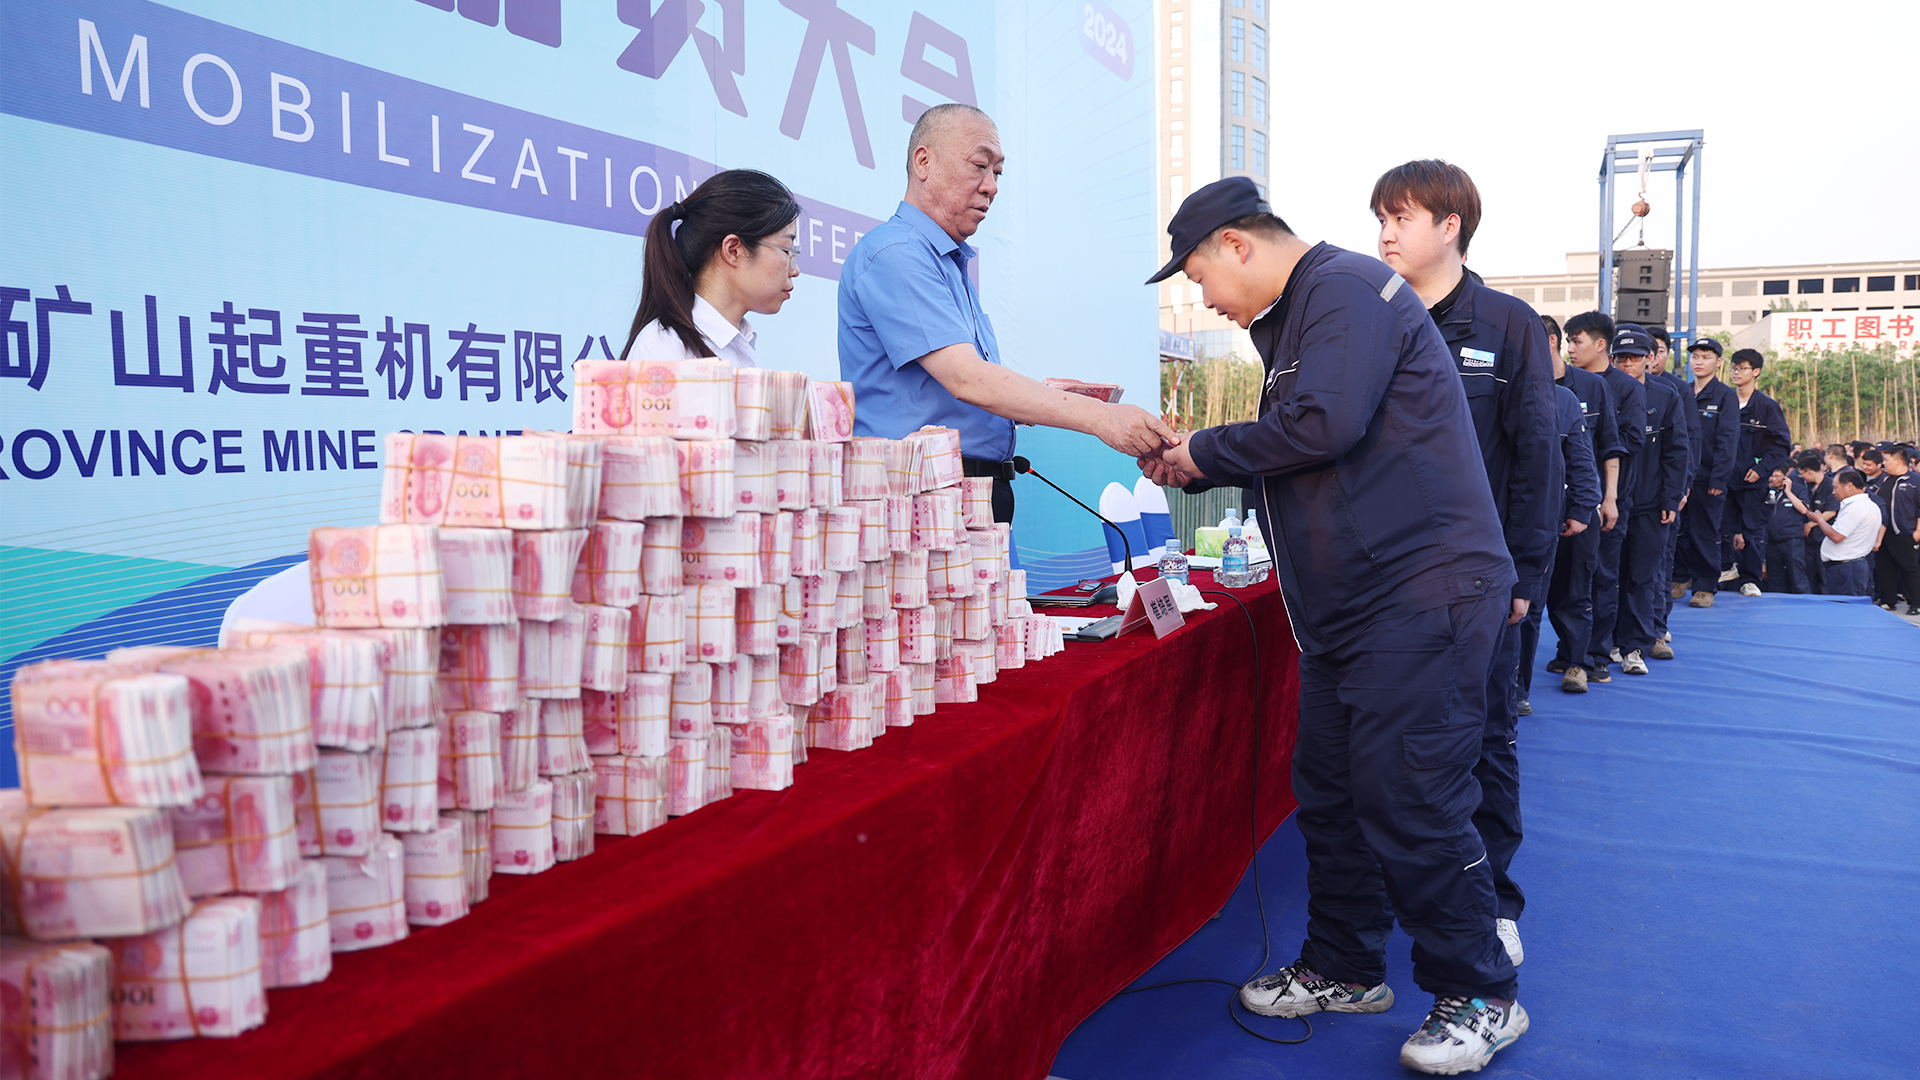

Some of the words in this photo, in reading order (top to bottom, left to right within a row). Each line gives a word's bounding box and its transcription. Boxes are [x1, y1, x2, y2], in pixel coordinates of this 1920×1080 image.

[1083, 3, 1127, 64] 2024
[1787, 314, 1914, 340] 职工图书
[0, 428, 246, 480] OVINCE
[262, 430, 378, 472] MINE
